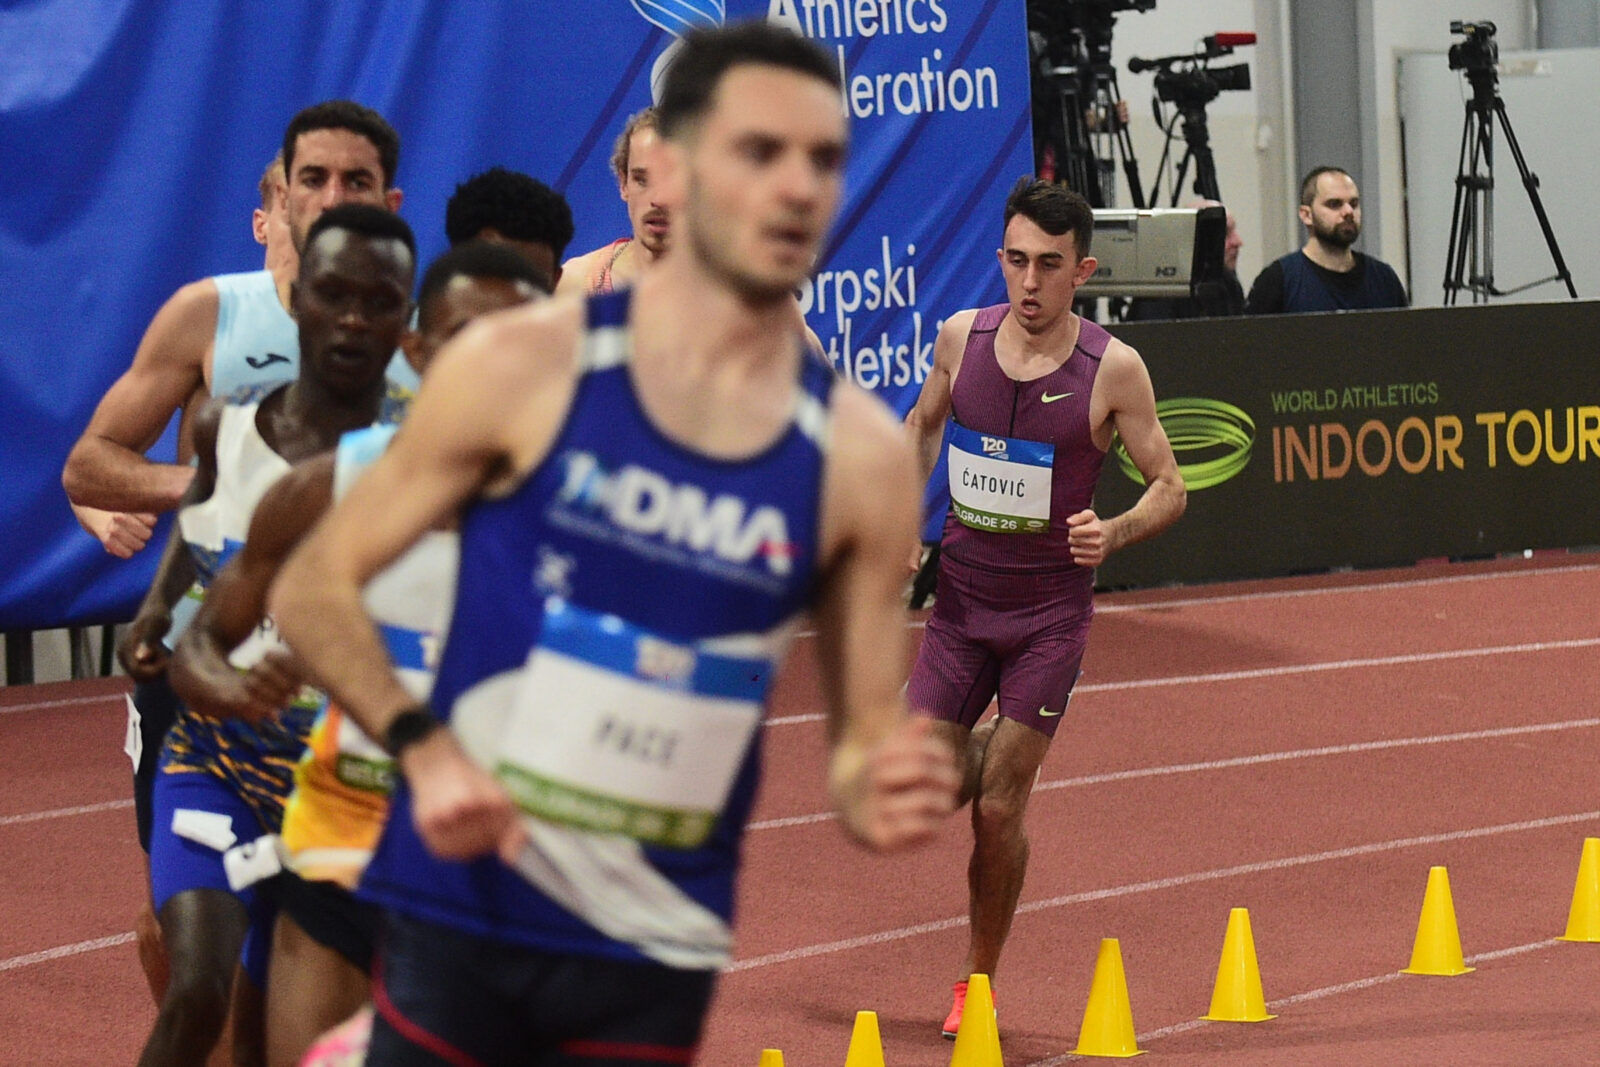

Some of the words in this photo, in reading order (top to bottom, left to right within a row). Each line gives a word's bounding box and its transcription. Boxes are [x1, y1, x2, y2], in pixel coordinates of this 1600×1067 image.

[1271, 388, 1338, 414] WORLD
[1341, 382, 1439, 409] ATHLETICS
[981, 436, 1007, 452] 120
[1271, 414, 1465, 483] INDOOR
[1475, 405, 1600, 468] TOUR
[962, 467, 1026, 498] ĆATOVIĆ
[1000, 519, 1018, 530] 26
